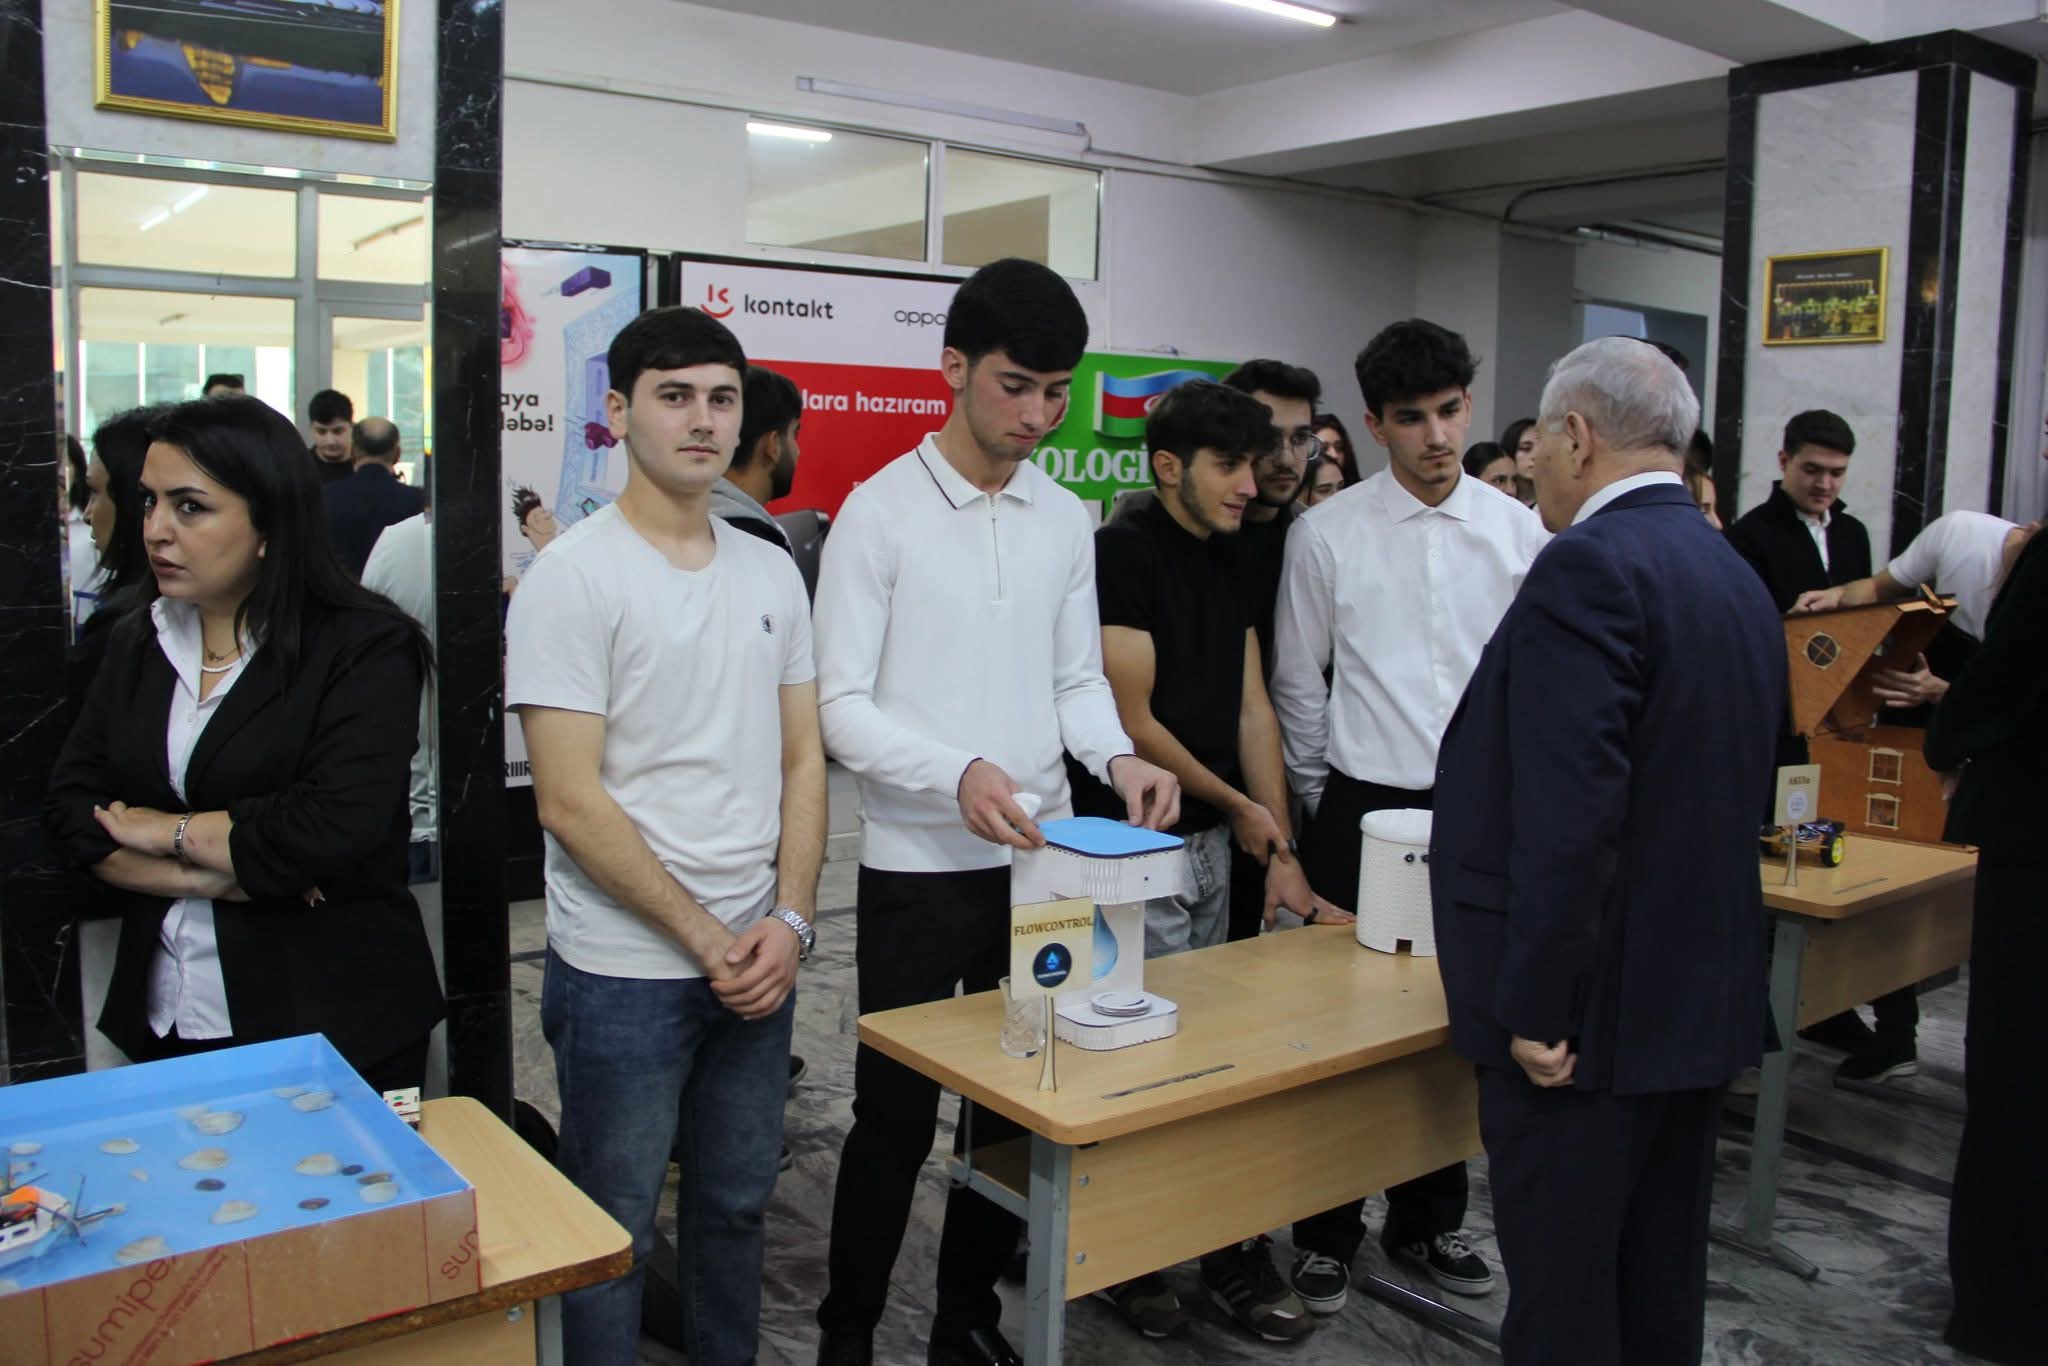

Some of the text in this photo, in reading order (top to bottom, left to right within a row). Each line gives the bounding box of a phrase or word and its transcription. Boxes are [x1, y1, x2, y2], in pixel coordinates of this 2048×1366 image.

[744, 294, 834, 319] kontakt
[855, 391, 947, 415] hazıram
[1013, 916, 1095, 937] FLOWCONTROL
